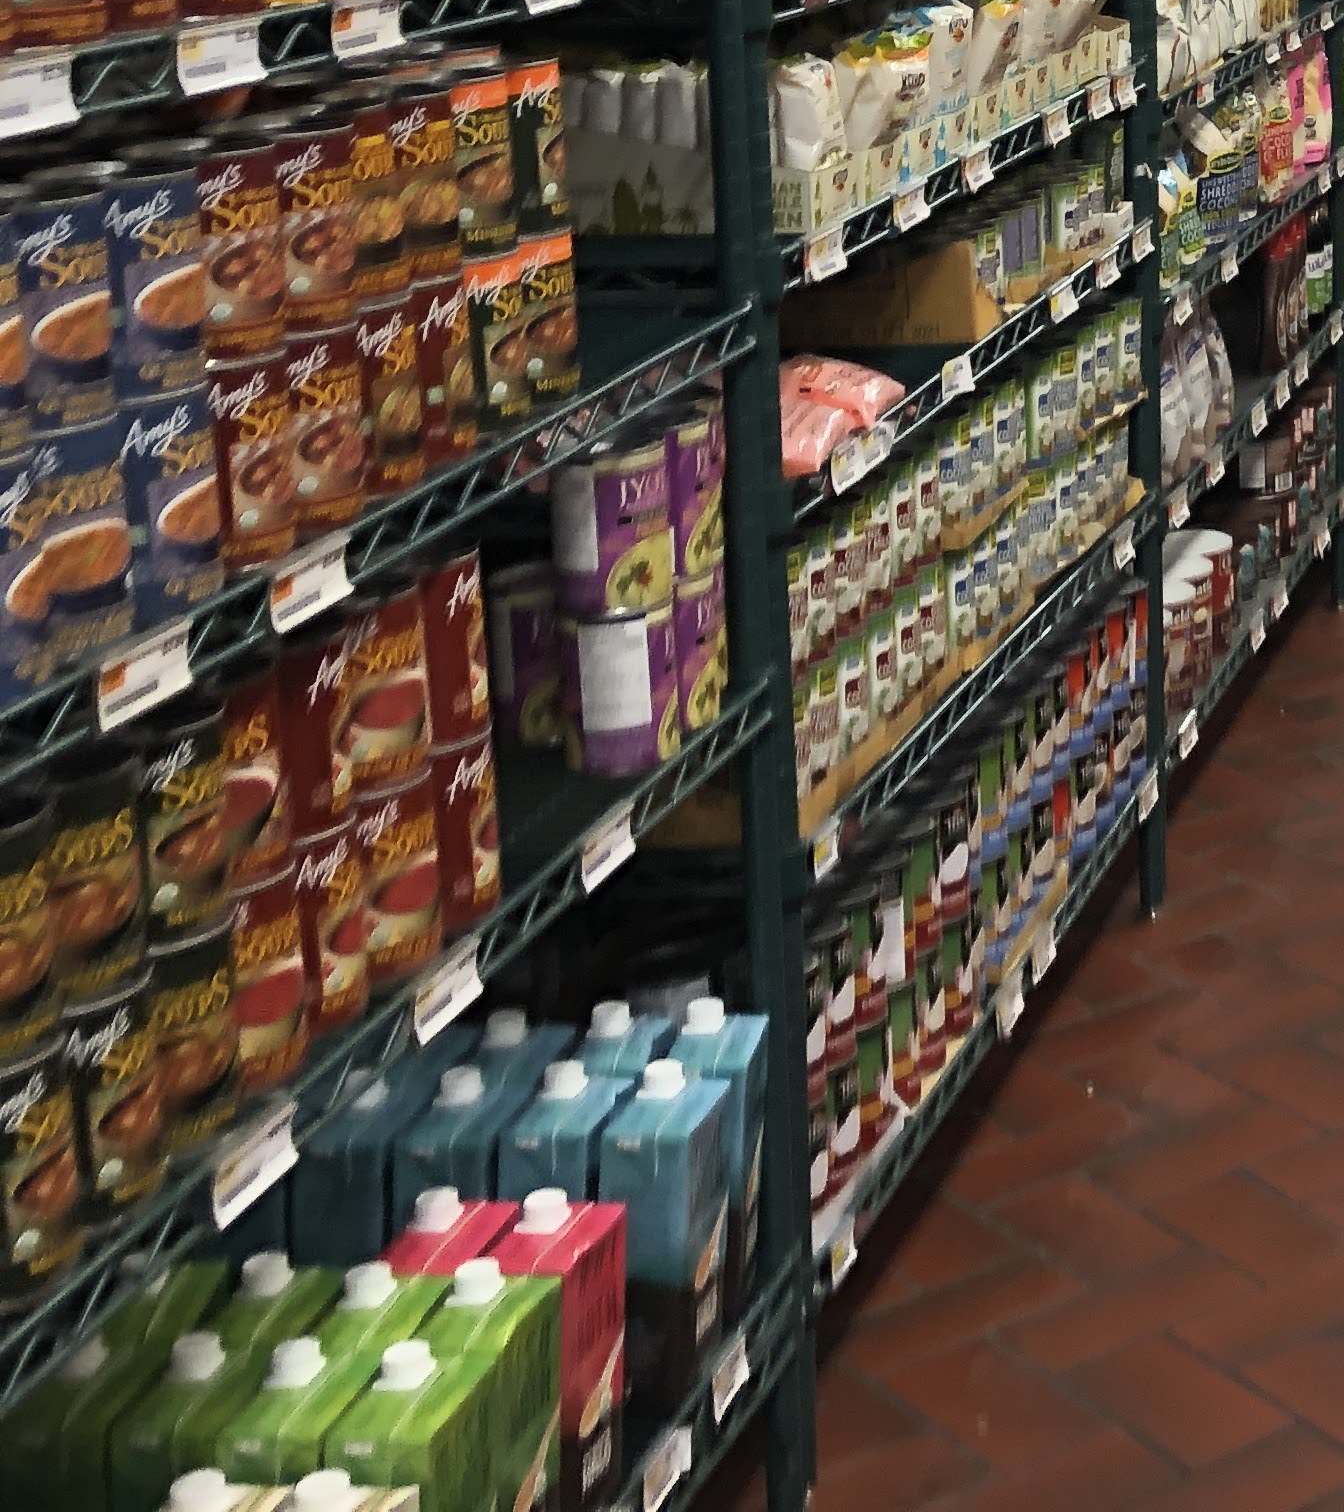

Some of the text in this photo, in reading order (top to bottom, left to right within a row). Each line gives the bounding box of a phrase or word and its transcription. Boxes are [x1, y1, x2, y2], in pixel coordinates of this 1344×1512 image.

[389, 106, 430, 148] my's
[452, 91, 483, 128] my's
[198, 163, 247, 210] my's
[276, 144, 325, 188] my's
[104, 188, 176, 239] Amy's
[14, 213, 77, 266] my's
[519, 246, 550, 285] my's
[285, 342, 332, 389] my's
[208, 370, 270, 421] Amy's
[119, 404, 192, 462] Amy's
[356, 798, 399, 846] my's
